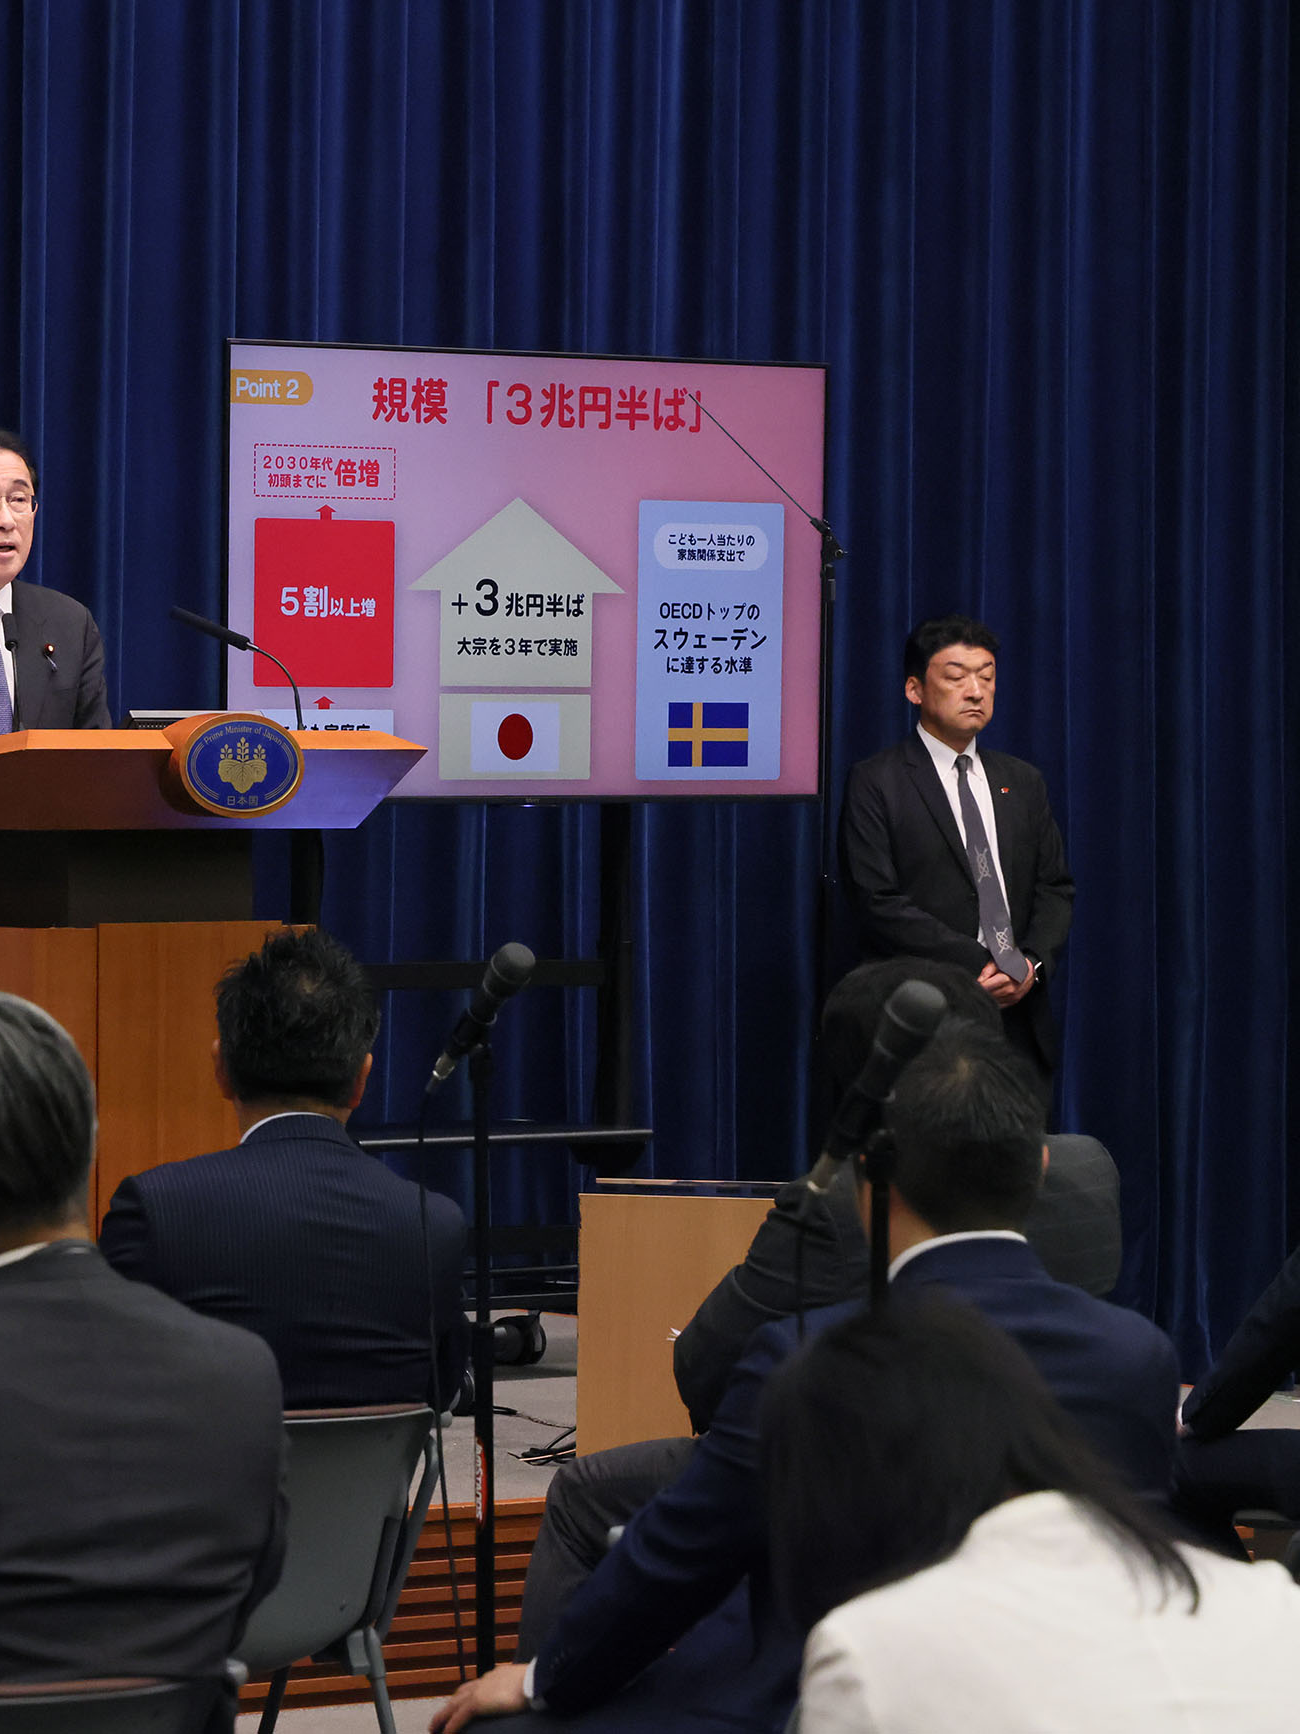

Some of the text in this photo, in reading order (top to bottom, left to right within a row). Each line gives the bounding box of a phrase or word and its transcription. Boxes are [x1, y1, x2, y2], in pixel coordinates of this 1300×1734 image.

[235, 376, 300, 400] Point 2
[371, 377, 702, 433] 規模 「3兆円半ば」
[262, 455, 334, 472] 2030年代
[334, 458, 381, 488] 倍増
[267, 472, 327, 489] 初頭までに
[667, 532, 756, 547] こども一人当たりの
[676, 548, 746, 562] 家族関係支出で
[280, 585, 377, 618] 5割以上増
[659, 602, 761, 621] OECDトップの
[457, 636, 579, 657] 大宗を3年で実施
[653, 627, 767, 651] スウェーデン
[666, 656, 753, 675] に達する水準
[203, 725, 283, 746] Prime Minister of Japan
[227, 795, 259, 806] 日本国
